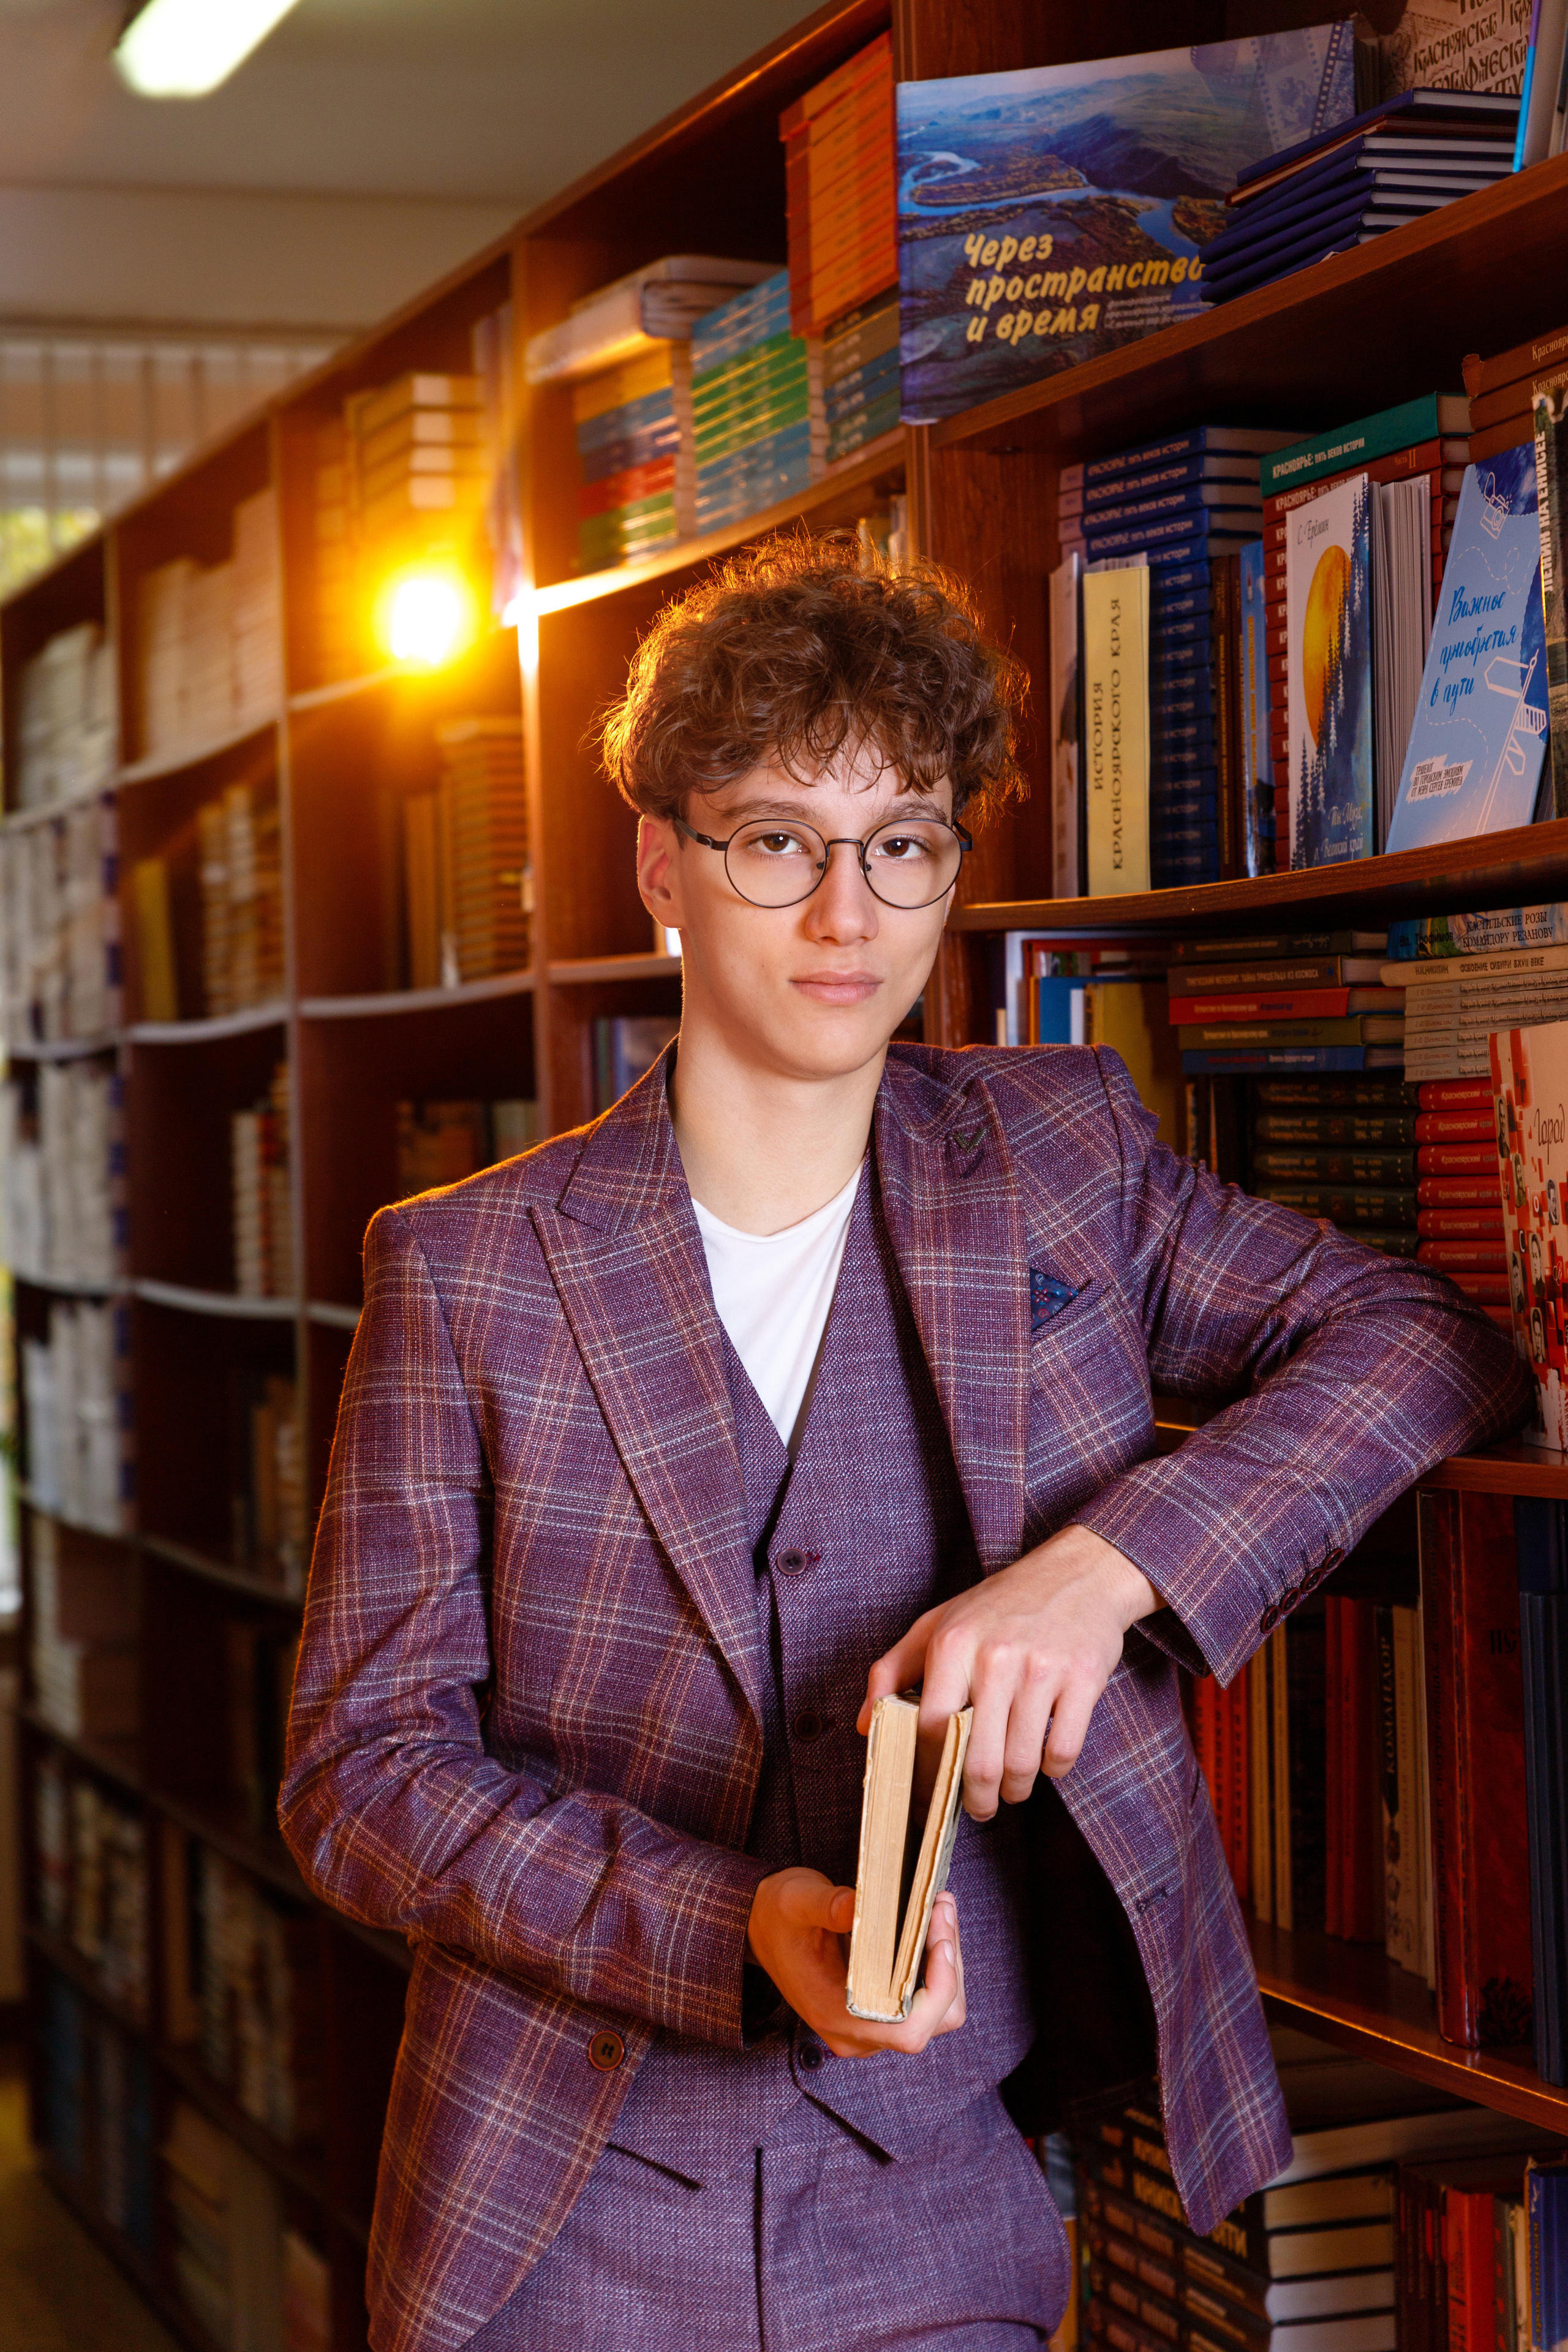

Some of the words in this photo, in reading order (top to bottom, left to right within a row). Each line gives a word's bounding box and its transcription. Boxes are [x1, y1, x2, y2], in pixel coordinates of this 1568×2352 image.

[963, 233, 1054, 273] Через
[965, 255, 1205, 312] пространство
[965, 316, 989, 343] и
[995, 304, 1101, 346] время
[1535, 430, 1549, 499] ЕНИСЕЕ
[1538, 500, 1550, 529] НА
[1540, 530, 1553, 593] ЛЕНИН
[1448, 586, 1506, 626] Важное
[1110, 598, 1121, 658] КРАЯ
[1443, 677, 1474, 716] пути
[1093, 682, 1103, 791] ИСТОРИЯ
[1110, 669, 1123, 870] КРАСНОЯРСКОГО
[1415, 932, 1454, 946] Трофимов
[1462, 933, 1510, 948] КОМАНДОРУ
[1512, 927, 1554, 943] РЕЗАНОВУ
[1466, 914, 1523, 932] КАСТИЛЬСКИЕ
[1525, 911, 1548, 925] РОЗЫ
[1460, 962, 1488, 973] ОСВОЕНИЕ
[1490, 960, 1512, 971] СИБИРИ
[1531, 957, 1544, 967] ВЕКЕ
